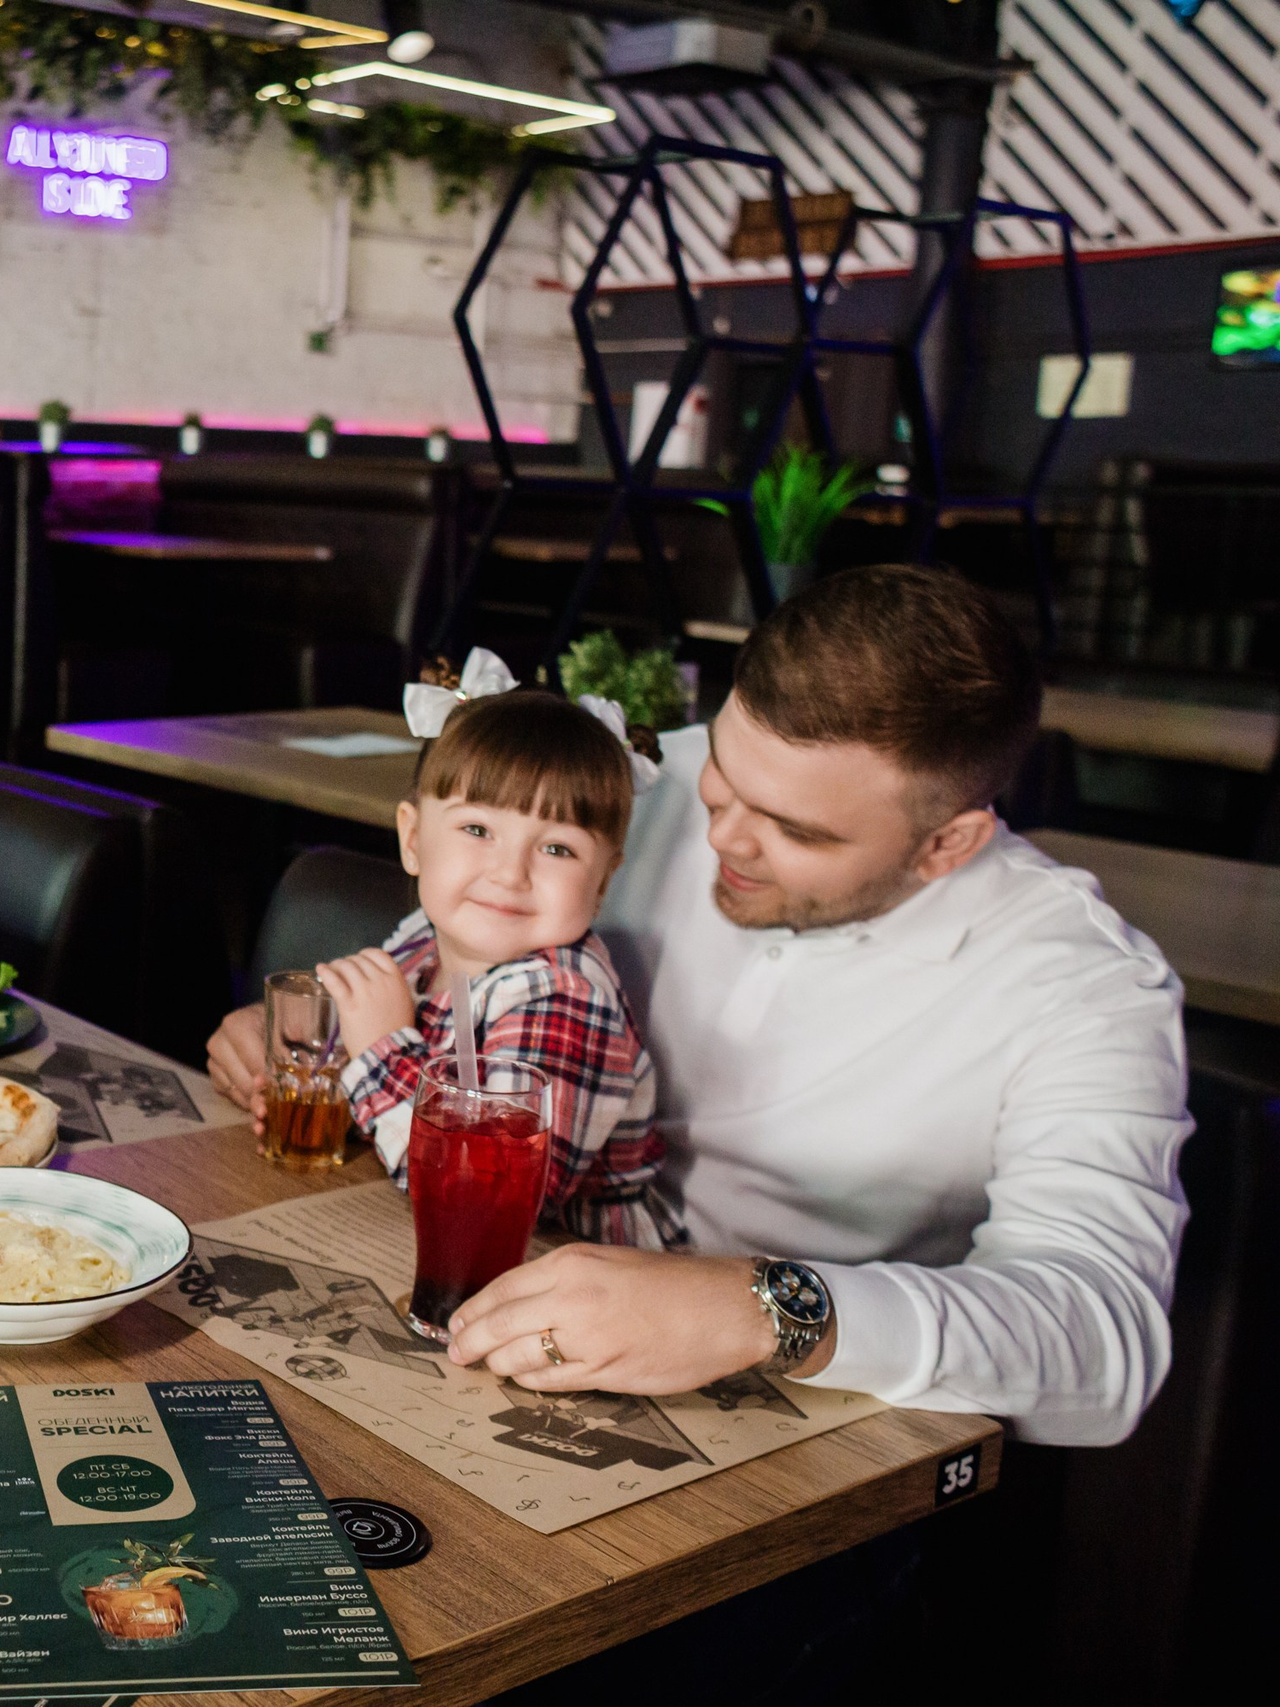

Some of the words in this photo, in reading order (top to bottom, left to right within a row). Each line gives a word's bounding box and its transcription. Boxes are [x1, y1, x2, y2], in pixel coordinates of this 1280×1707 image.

[175, 1255, 220, 1307] DOS
[52, 1388, 115, 1397] DOSKI
[160, 1389, 260, 1398] НАПИТКИ
[38, 1415, 149, 1426] ОБЕДЕННЫЙ
[40, 1424, 152, 1436] SPECIAL
[518, 1433, 599, 1456] DOSKI
[89, 1463, 130, 1471] ПТ-СБ
[73, 1470, 152, 1479] 12:00-17:00
[942, 1454, 974, 1494] 35
[97, 1485, 137, 1493] ВС-ЧТ
[79, 1493, 161, 1502] 12:00-19:00
[245, 1495, 316, 1503] Виски-Кола
[272, 1524, 330, 1532] Коктейль
[210, 1535, 271, 1543] Заводной
[274, 1532, 333, 1540] апельсин
[259, 1594, 326, 1603] Инкерман
[330, 1592, 368, 1600] Буссо
[19, 1613, 68, 1621] Хеллес
[283, 1628, 318, 1636] Вино
[321, 1626, 384, 1635] Игристое
[333, 1635, 390, 1643] Меланж
[0, 1650, 50, 1658] Вайзен
